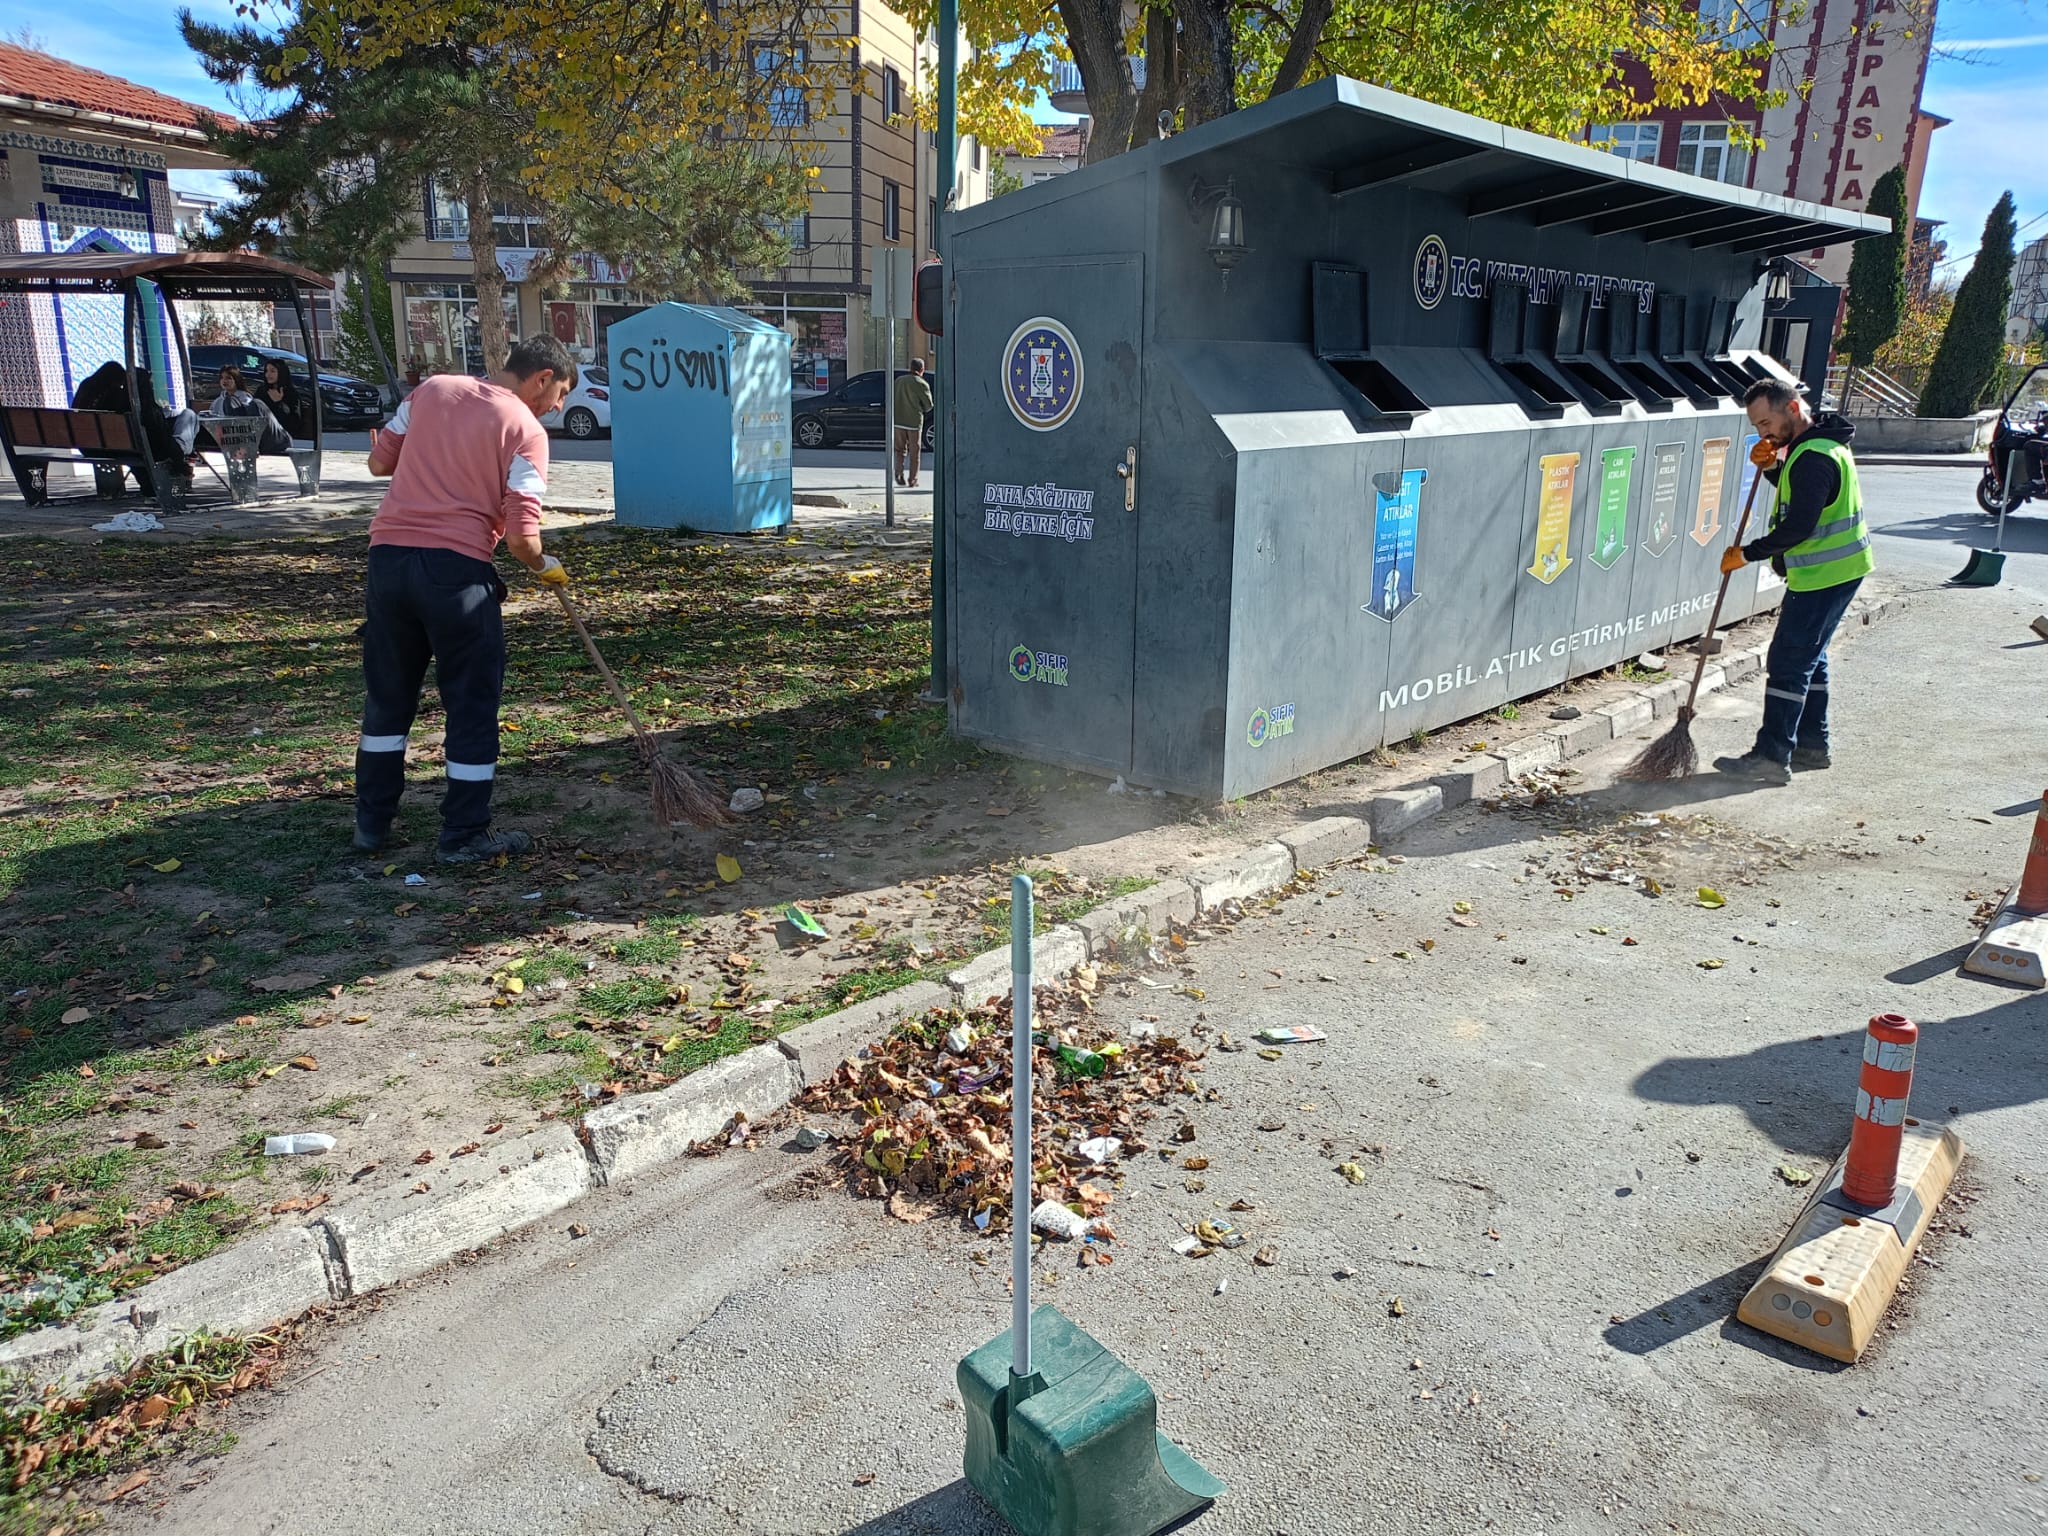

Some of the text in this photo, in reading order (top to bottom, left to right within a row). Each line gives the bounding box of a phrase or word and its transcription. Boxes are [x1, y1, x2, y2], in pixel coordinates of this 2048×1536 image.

[1451, 256, 1482, 298] T.C.
[984, 482, 1094, 512] DAHA SAĞLIKLI
[984, 505, 1094, 543] BİR ÇEVRE İÇİN
[1383, 504, 1414, 522] ATIKLAR
[1036, 651, 1069, 669] SIFIR
[1378, 663, 1478, 712] MOBİL
[1484, 643, 1544, 680] ATIK
[1549, 613, 1646, 657] GETİRME
[1036, 666, 1069, 686] ATIK
[1270, 702, 1295, 723] SIFIR
[1269, 716, 1294, 739] ATIK
